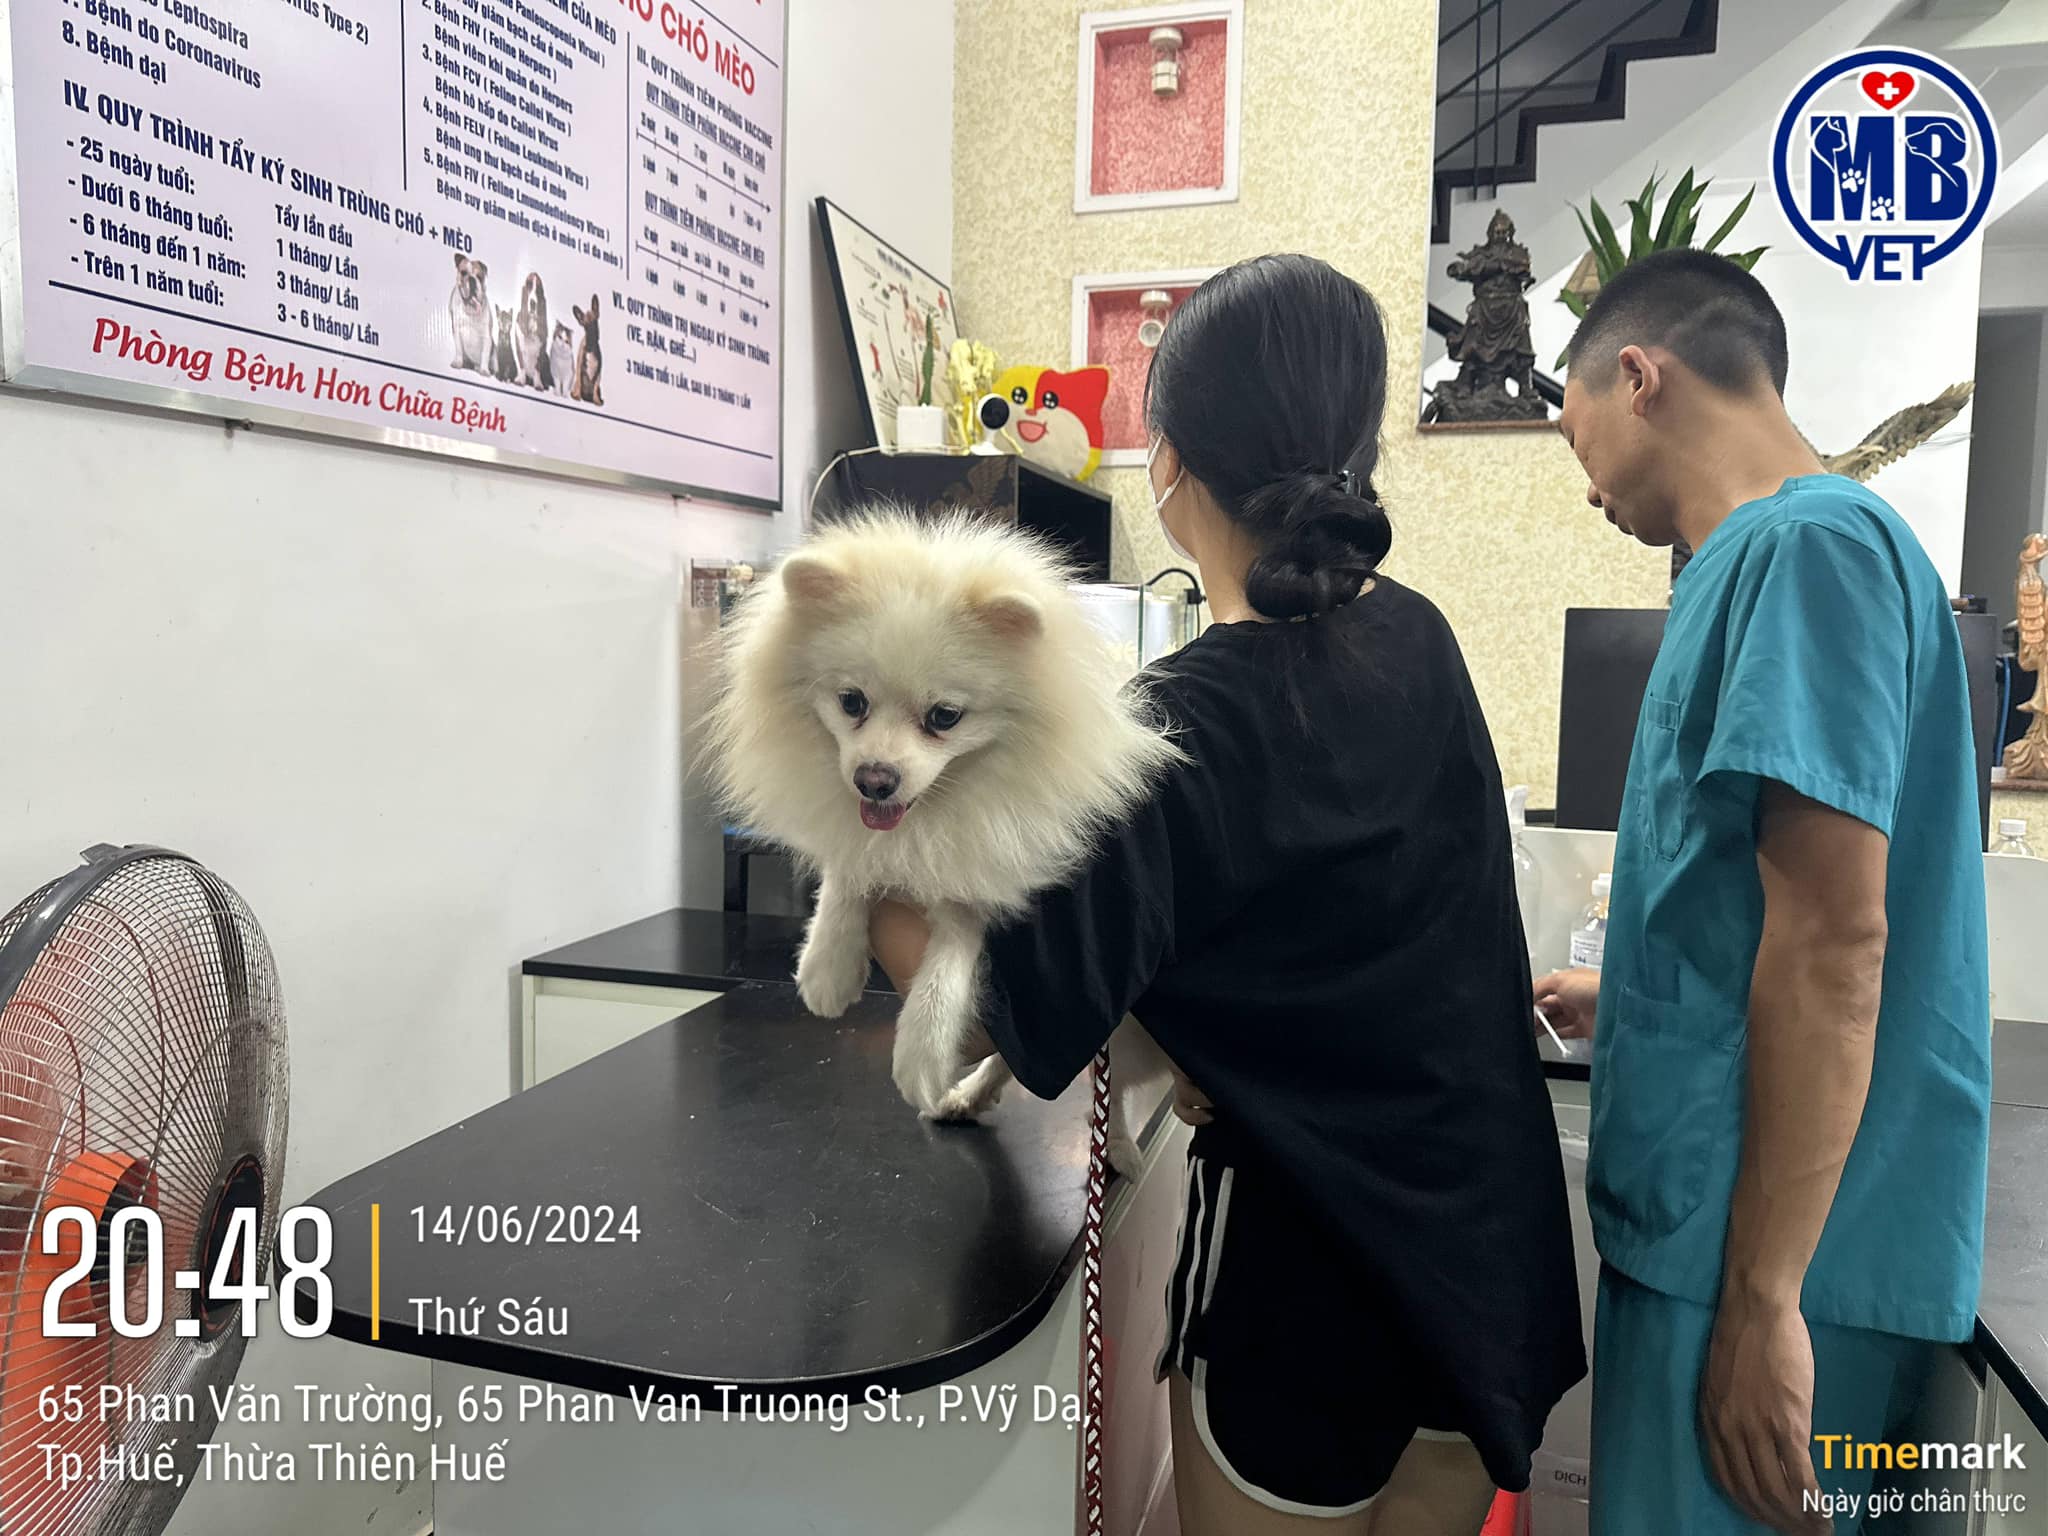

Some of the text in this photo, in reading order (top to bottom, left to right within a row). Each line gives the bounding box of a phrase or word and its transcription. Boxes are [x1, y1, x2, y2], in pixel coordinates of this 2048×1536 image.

[322, 3, 352, 35] Type
[356, 22, 368, 45] 2)
[434, 0, 459, 26] Bệnh
[462, 15, 480, 37] FHV
[489, 30, 516, 58] Feline
[481, 4, 504, 28] giảm
[506, 17, 528, 42] bạch
[571, 1, 592, 30] CỦA
[595, 16, 616, 45] MÈO
[661, 2, 755, 96] CHÓ MÈO
[62, 20, 166, 85] 8. Bệnh dại
[138, 17, 159, 43] do
[165, 28, 261, 89] Coronavirus
[434, 24, 460, 50] Bệnh
[462, 41, 486, 64] viêm
[529, 79, 539, 96] do
[651, 55, 668, 79] QUY
[670, 67, 695, 97] TRÌNH
[422, 43, 566, 133] 3. Bệnh FCV Feline Virus
[435, 76, 460, 102] Bệnh
[478, 97, 495, 120] hấp
[498, 109, 508, 127] do
[538, 128, 558, 152] Virus
[80, 136, 195, 194] 25 ngày tuổi:
[423, 96, 433, 114] 4.
[436, 102, 461, 128] Bệnh
[463, 116, 485, 138] FELV
[494, 131, 520, 155] Feline
[564, 164, 584, 187] Virus
[436, 127, 461, 153] Bệnh
[464, 143, 481, 163] ung
[484, 150, 499, 170] thư
[501, 157, 522, 180] bạch
[98, 94, 143, 132] QUY
[150, 113, 213, 159] TRÌNH
[219, 138, 255, 174] TẨY
[261, 156, 285, 185] KÝ
[291, 168, 332, 203] SINH
[338, 186, 390, 224] TRÙNG
[395, 208, 424, 235] CHÓ
[443, 226, 472, 254] MÈO
[424, 147, 433, 165] 5.
[436, 152, 462, 178] Bệnh
[464, 165, 479, 184] FIV
[487, 176, 514, 200] Feline
[437, 178, 462, 200] Bệnh
[464, 191, 481, 210] suy
[82, 174, 233, 241] Dưới 6 tháng tuổi:
[275, 204, 353, 248] Tẩy lần đầu
[83, 213, 246, 279] 6 tháng đến 1 năm:
[276, 238, 359, 280] 1 tháng/ Lần
[84, 250, 224, 306] Trên 1 năm tuổi:
[276, 270, 359, 311] 3 tháng/ Lần
[277, 303, 379, 346] 3 6 tháng/ Lần
[627, 297, 645, 318] QUY
[647, 304, 673, 328] TRÌNH
[728, 336, 746, 355] SINH
[92, 318, 508, 433] Phòng Bệnh Hơn Chữa Bệnh
